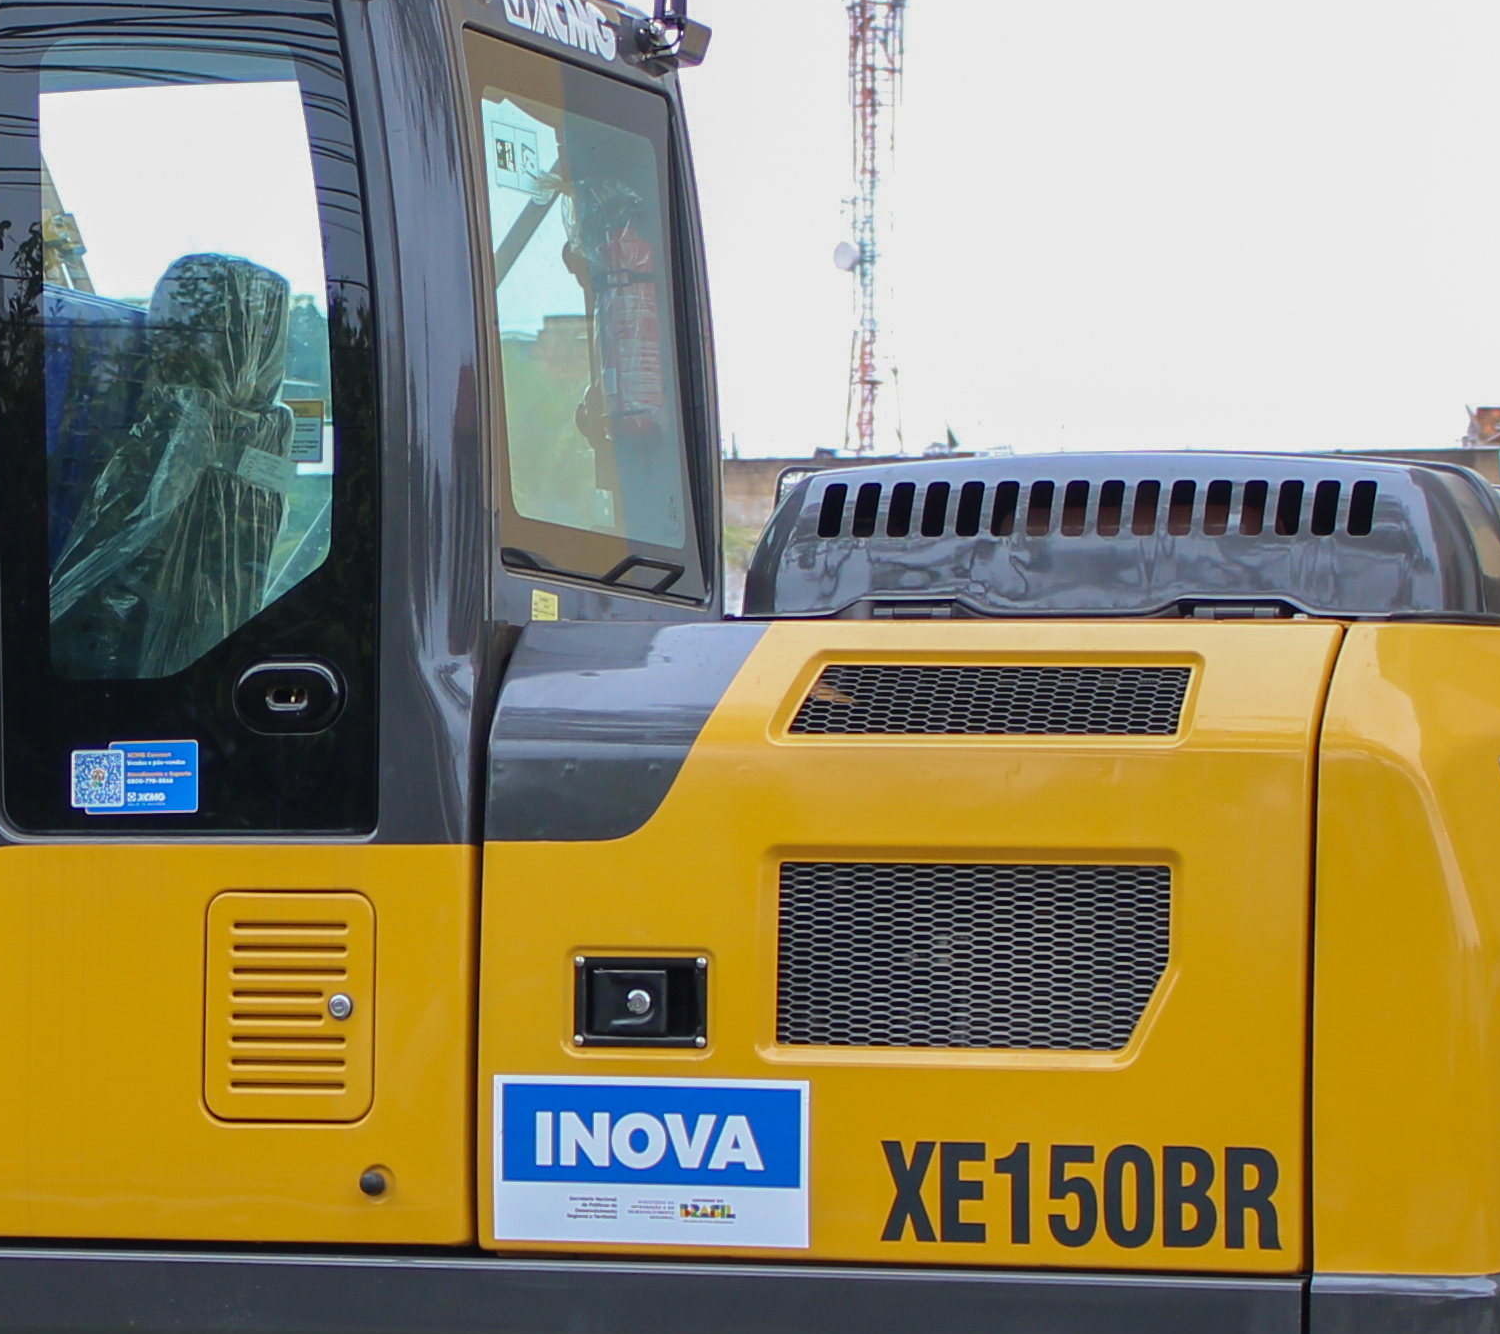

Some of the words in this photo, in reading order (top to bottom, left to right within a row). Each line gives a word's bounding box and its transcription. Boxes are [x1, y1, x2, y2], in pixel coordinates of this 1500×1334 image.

[535, 1111, 765, 1171] INOVA
[680, 1204, 736, 1219] BRASIL
[880, 1140, 1283, 1250] XE150BR
